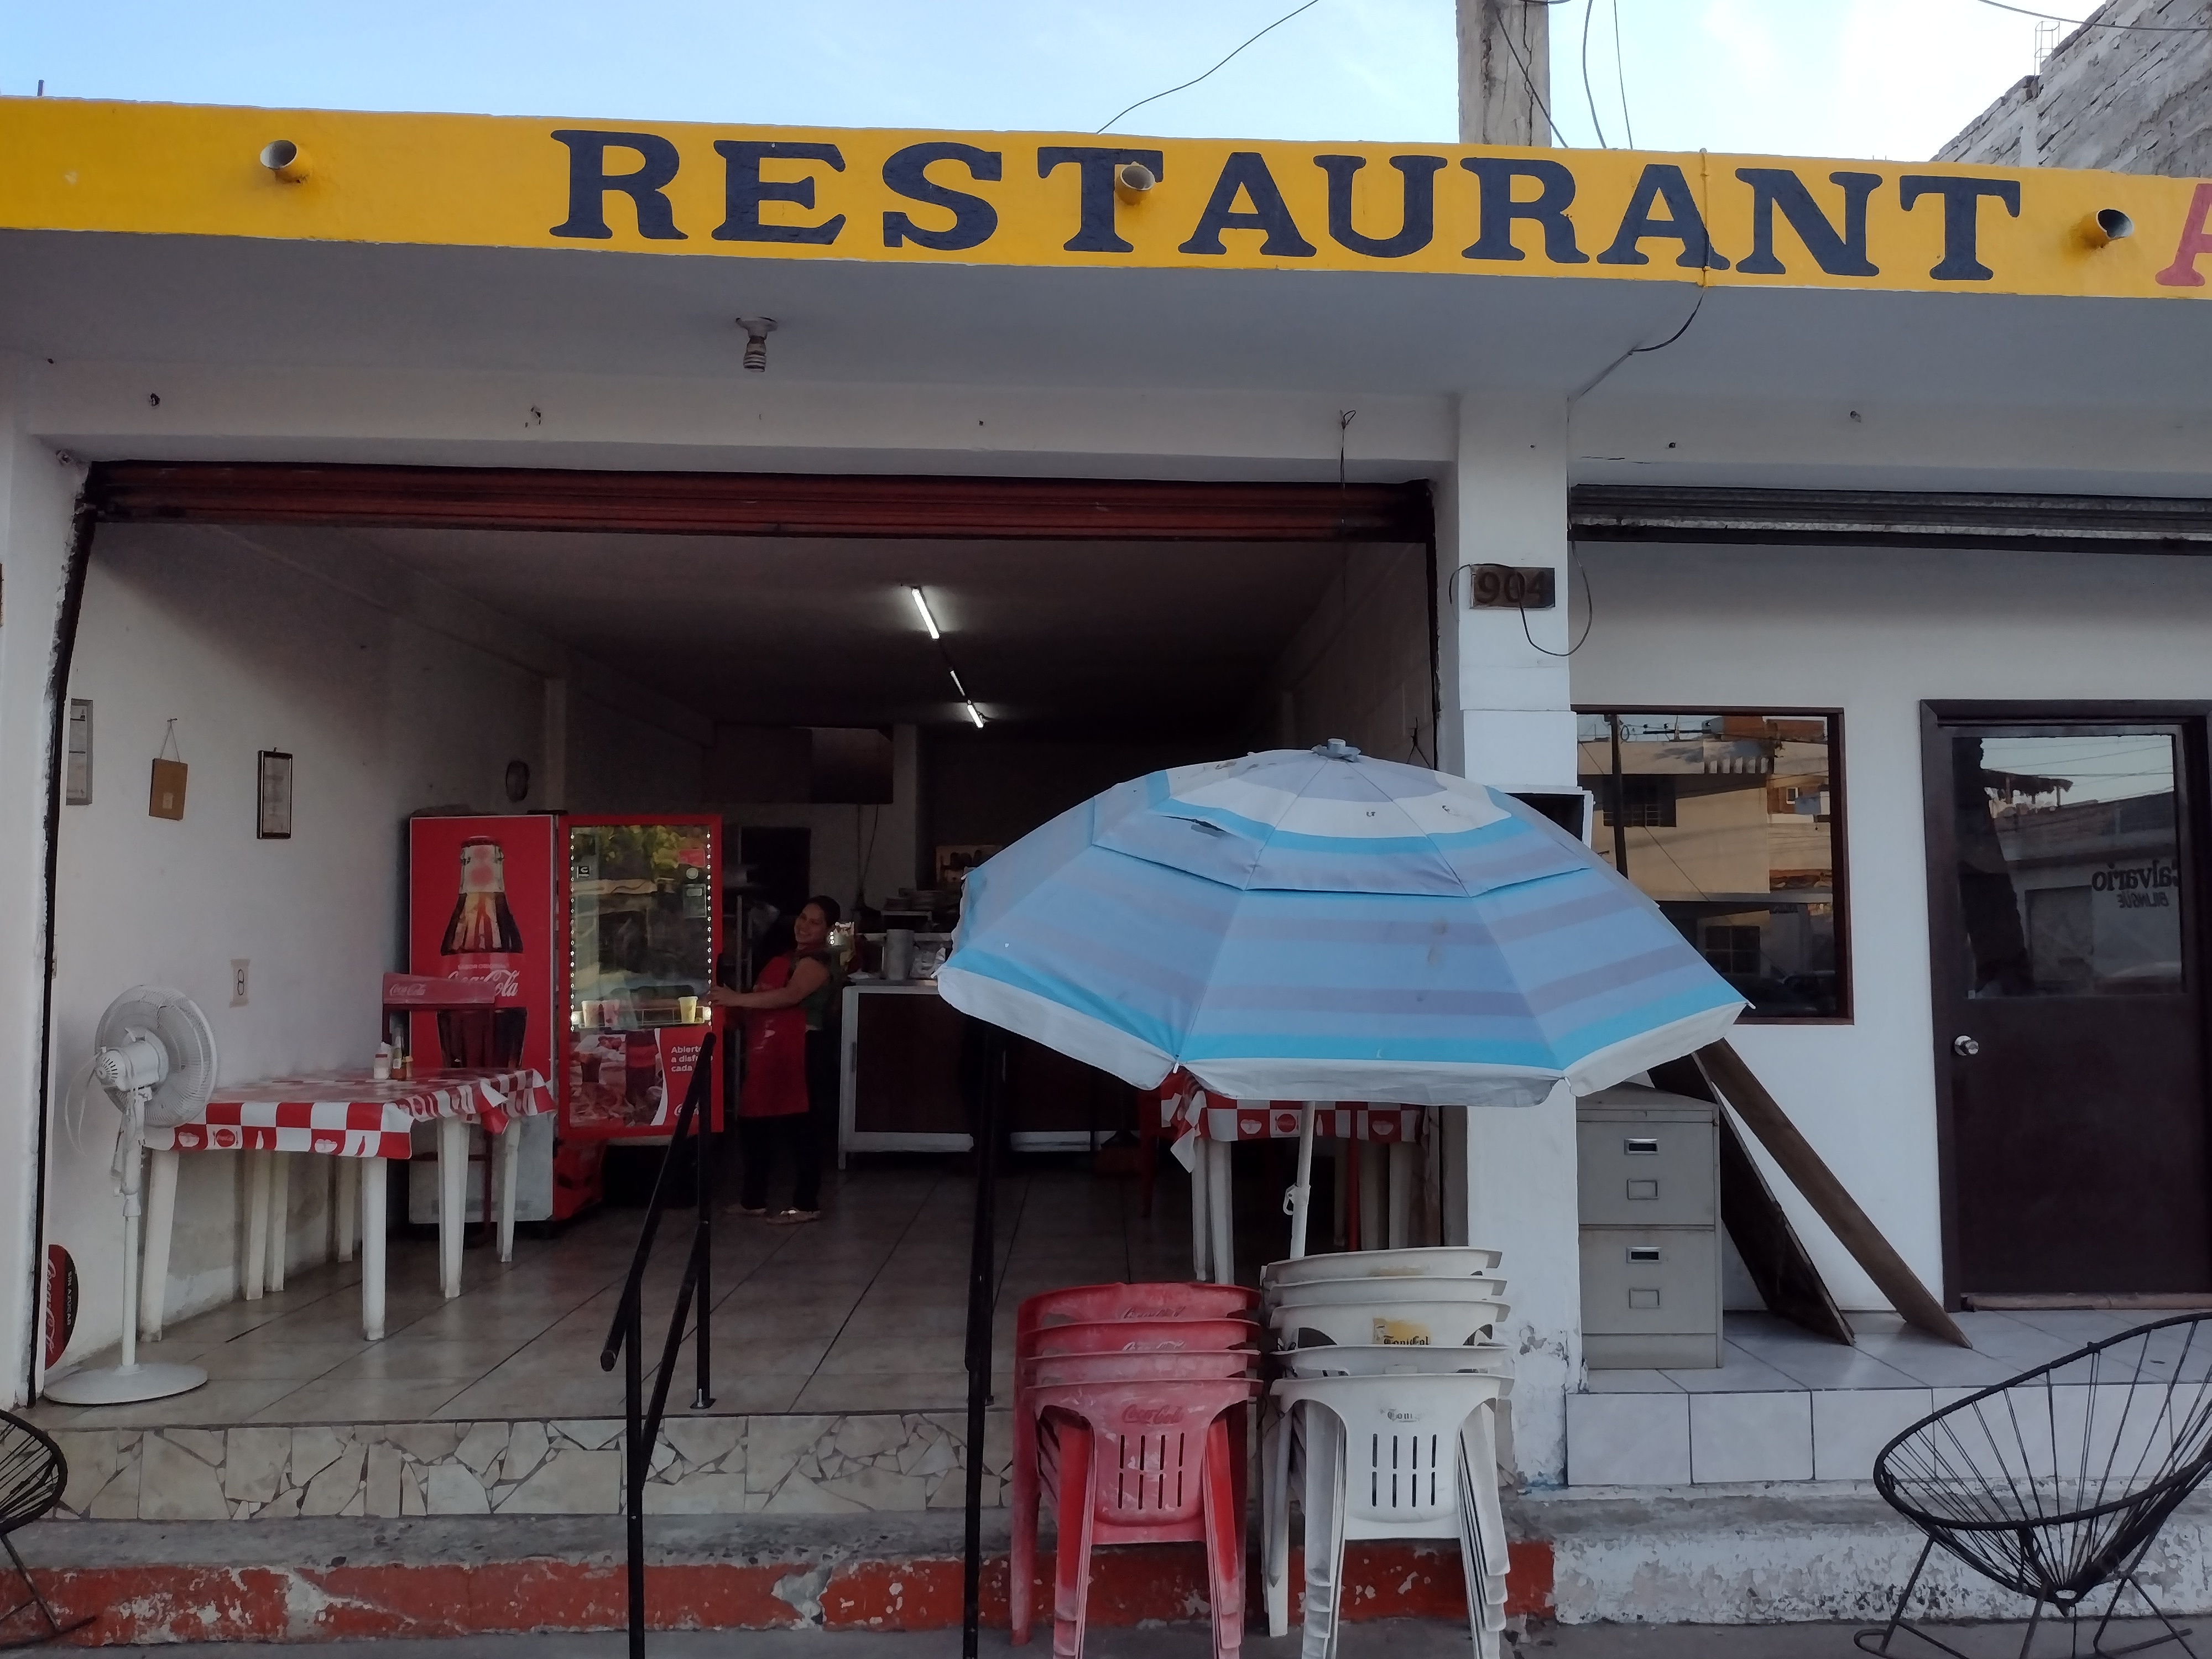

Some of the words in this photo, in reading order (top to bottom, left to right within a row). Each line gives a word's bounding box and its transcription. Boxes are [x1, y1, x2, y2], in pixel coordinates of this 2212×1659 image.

[549, 129, 2021, 282] RESTAURANT
[1475, 570, 1547, 604] 904
[671, 1064, 693, 1072] cada
